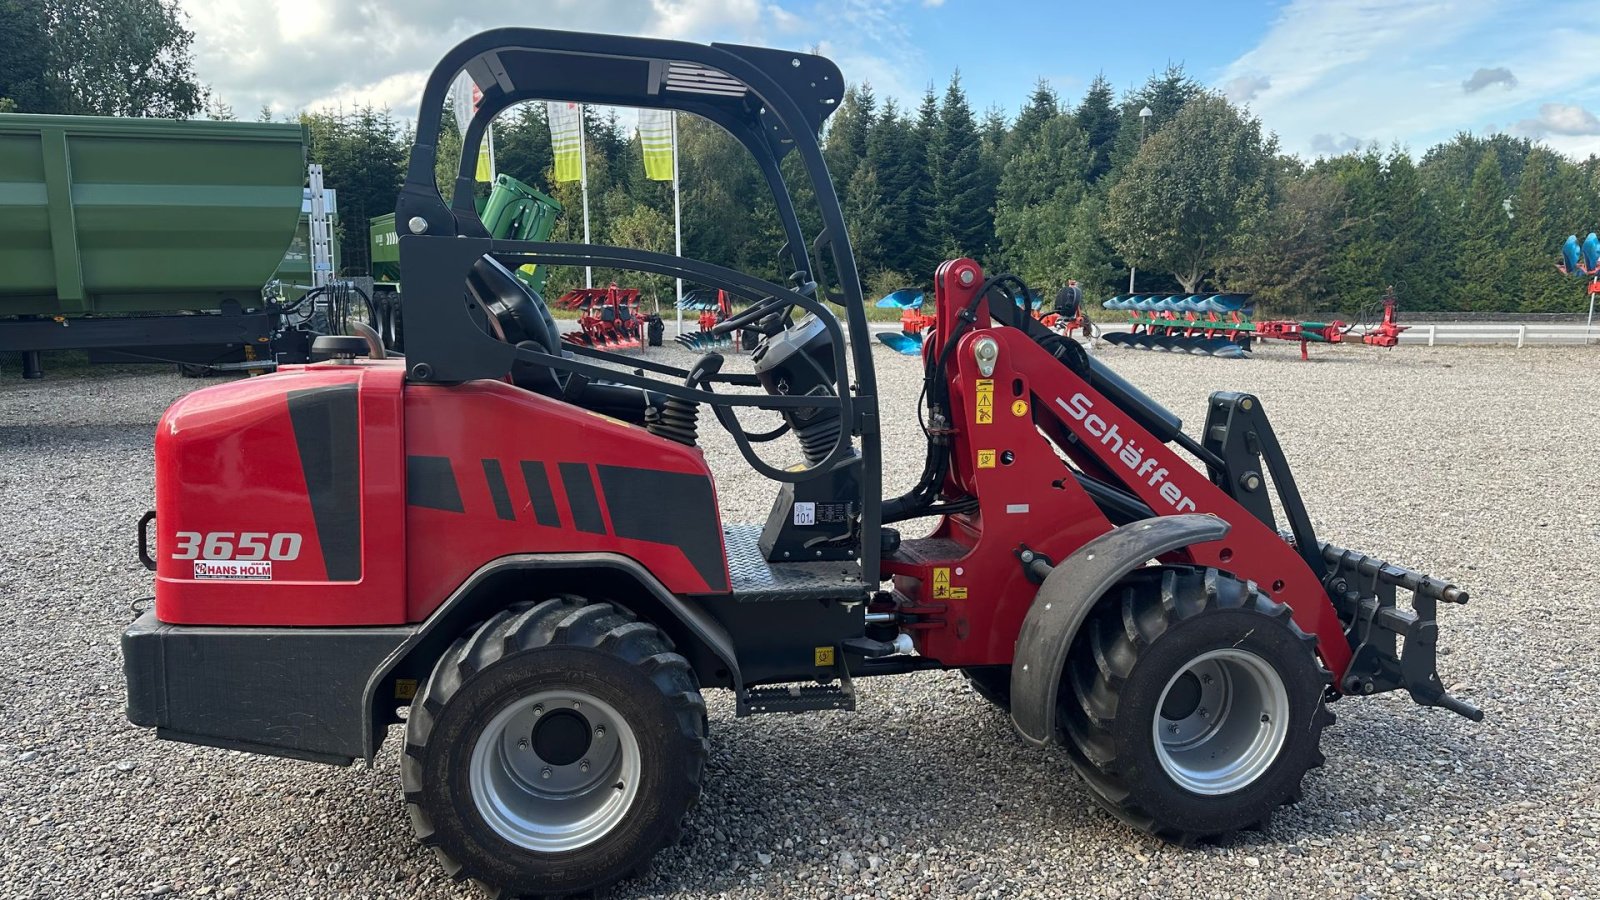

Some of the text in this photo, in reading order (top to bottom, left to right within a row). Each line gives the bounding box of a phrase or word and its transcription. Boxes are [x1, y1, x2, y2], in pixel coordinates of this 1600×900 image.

[1055, 392, 1196, 512] Schäffer
[796, 512, 810, 523] 101
[171, 531, 303, 561] 3650
[207, 566, 271, 575] HANS HOLM
